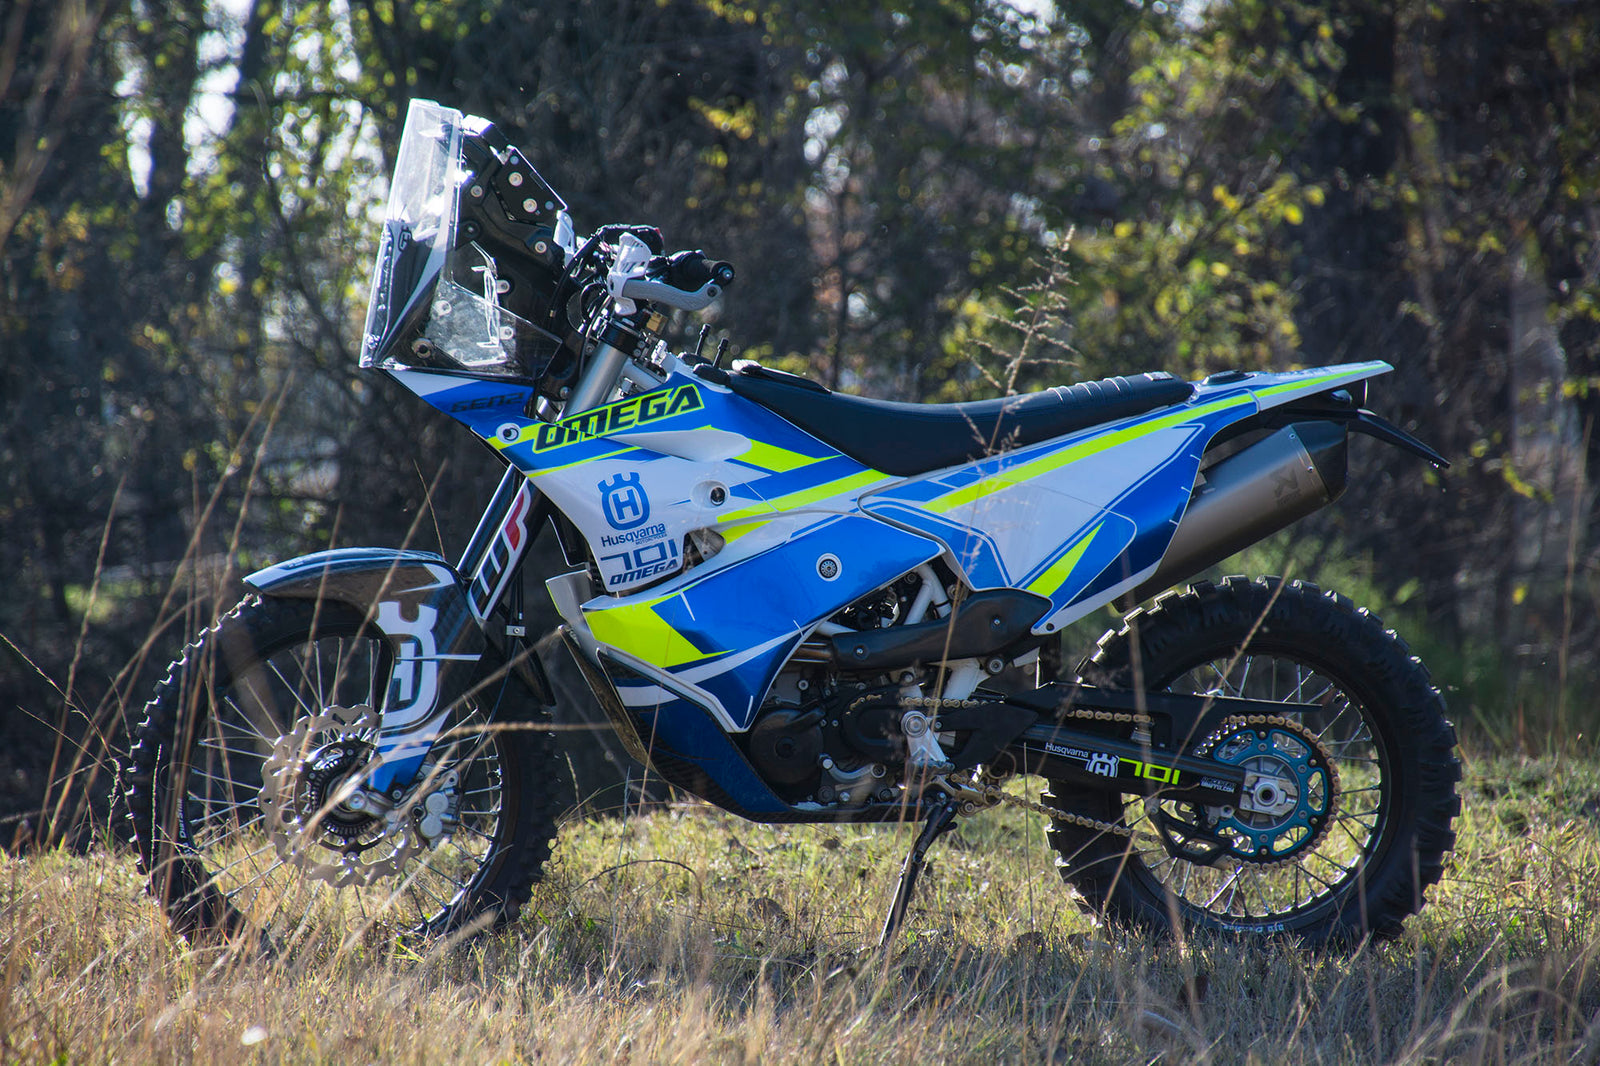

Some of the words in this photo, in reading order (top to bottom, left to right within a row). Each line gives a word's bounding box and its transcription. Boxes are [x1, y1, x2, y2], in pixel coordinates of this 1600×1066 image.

[533, 384, 704, 453] OMEGA
[601, 523, 666, 547] Husqvarna
[600, 539, 678, 571] 701
[609, 559, 678, 586] OMEGA
[1045, 742, 1089, 758] Husqvarna
[1119, 757, 1181, 785] 701
